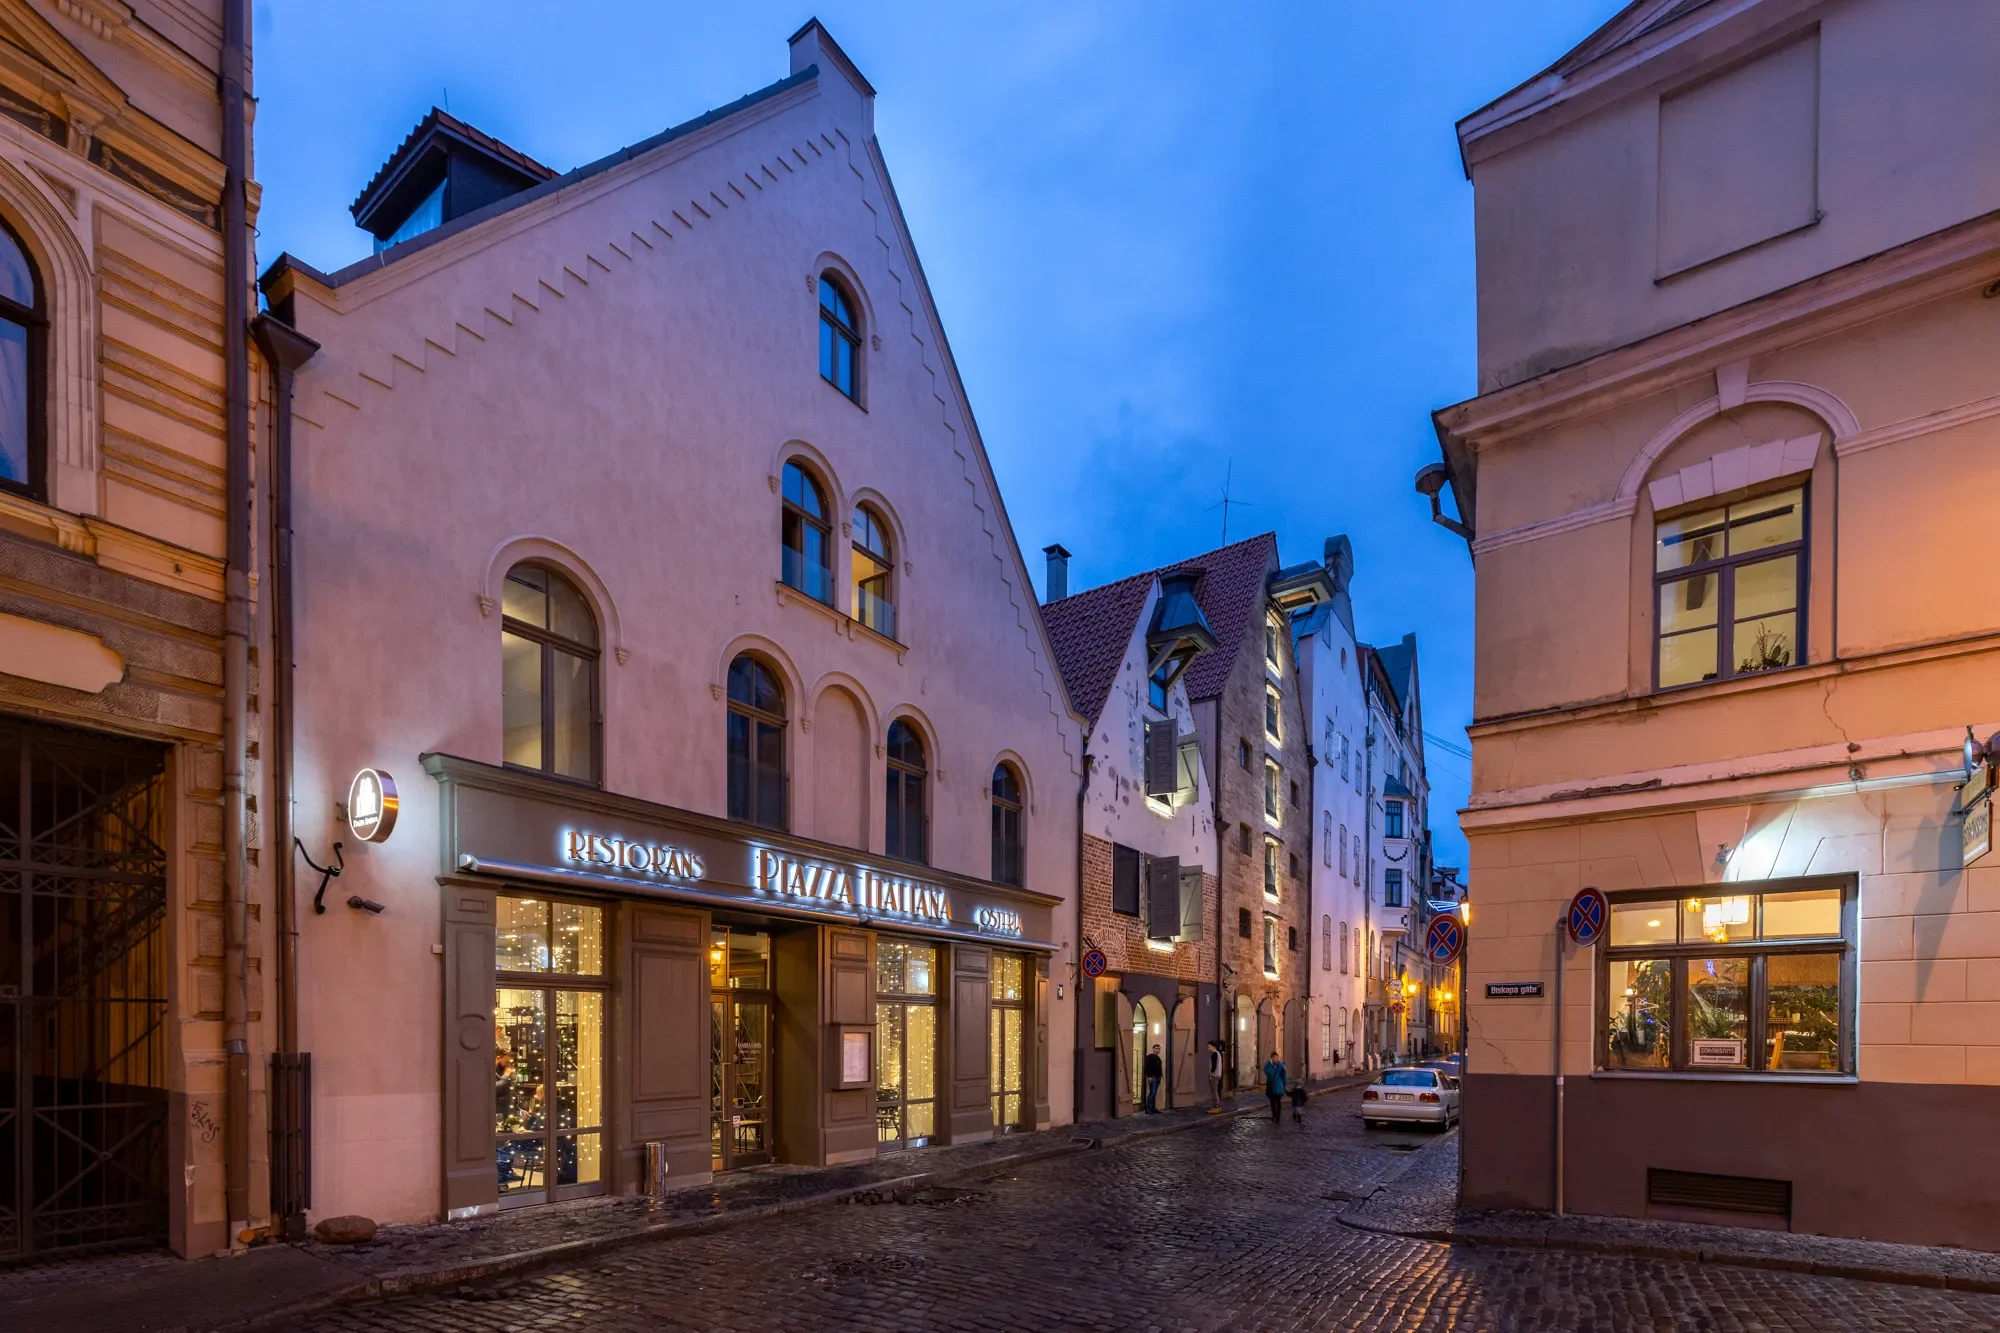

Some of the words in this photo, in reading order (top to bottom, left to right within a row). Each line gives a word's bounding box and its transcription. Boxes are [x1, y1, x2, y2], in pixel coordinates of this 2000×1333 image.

[568, 831, 706, 879] RESTORĀNS
[756, 849, 855, 905] PIAZZA
[864, 871, 952, 920] ITALIANA
[980, 909, 1023, 932] OSTERIA
